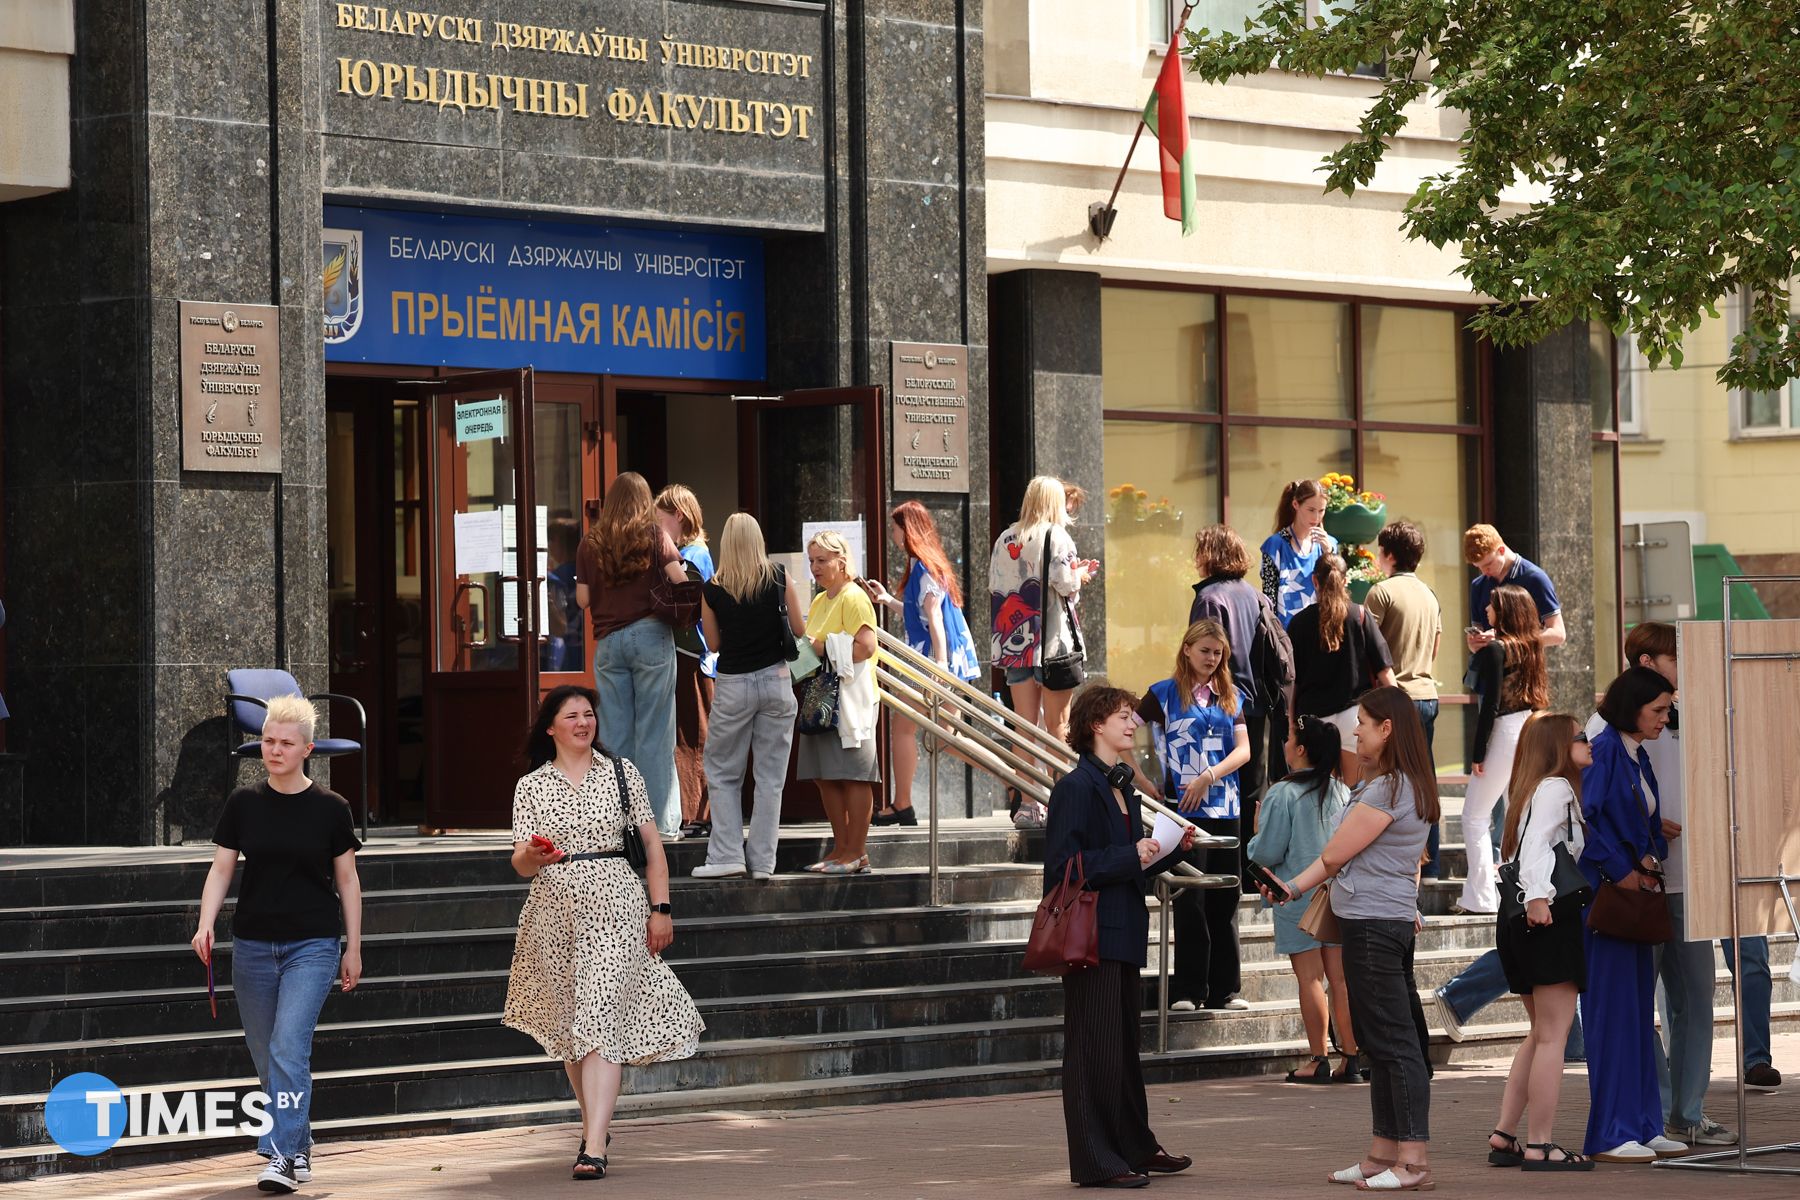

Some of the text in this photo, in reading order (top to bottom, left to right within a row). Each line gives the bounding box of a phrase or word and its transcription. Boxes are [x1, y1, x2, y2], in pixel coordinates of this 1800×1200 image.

[336, 3, 813, 78] БЕЛАРУСКІ ДЗЯРЖАЎНЫ ЎНІВЕРСІТЭТ
[337, 58, 814, 139] ЮРЫДЫЧНЫ ФАКУЛЬТЭТ
[390, 237, 746, 280] БЕЛАРУСКІ ДЗЯРЖАЎНЫ ЎНІВЕРСІТЭТ
[391, 286, 601, 345] ПРЫЁМНАЯ
[205, 342, 256, 356] БЕЛАРУСКІ
[200, 361, 261, 376] ДЗЯРЖАЎНЫ
[201, 378, 261, 394] ЎНІВЕРСІТЭТ
[905, 378, 955, 389] БЕЛОРУССКИЙ
[896, 395, 965, 407] ГОСУДАРСТВЕННЫЙ
[456, 405, 501, 420] ЭЛЕКТРОННАЯ
[905, 412, 956, 424] УНИВЕРСИТЕТ
[464, 422, 494, 435] ОЧЕРЕДЬ
[201, 430, 263, 445] ЮРЫДЫЧНЫ
[206, 446, 260, 458] ФАКУЛЬТЭТ
[904, 456, 959, 467] ЮРИДИЧЕСКИЙ
[911, 469, 952, 479] ФАКУЛЬТЕТ
[1009, 609, 1024, 625] 88
